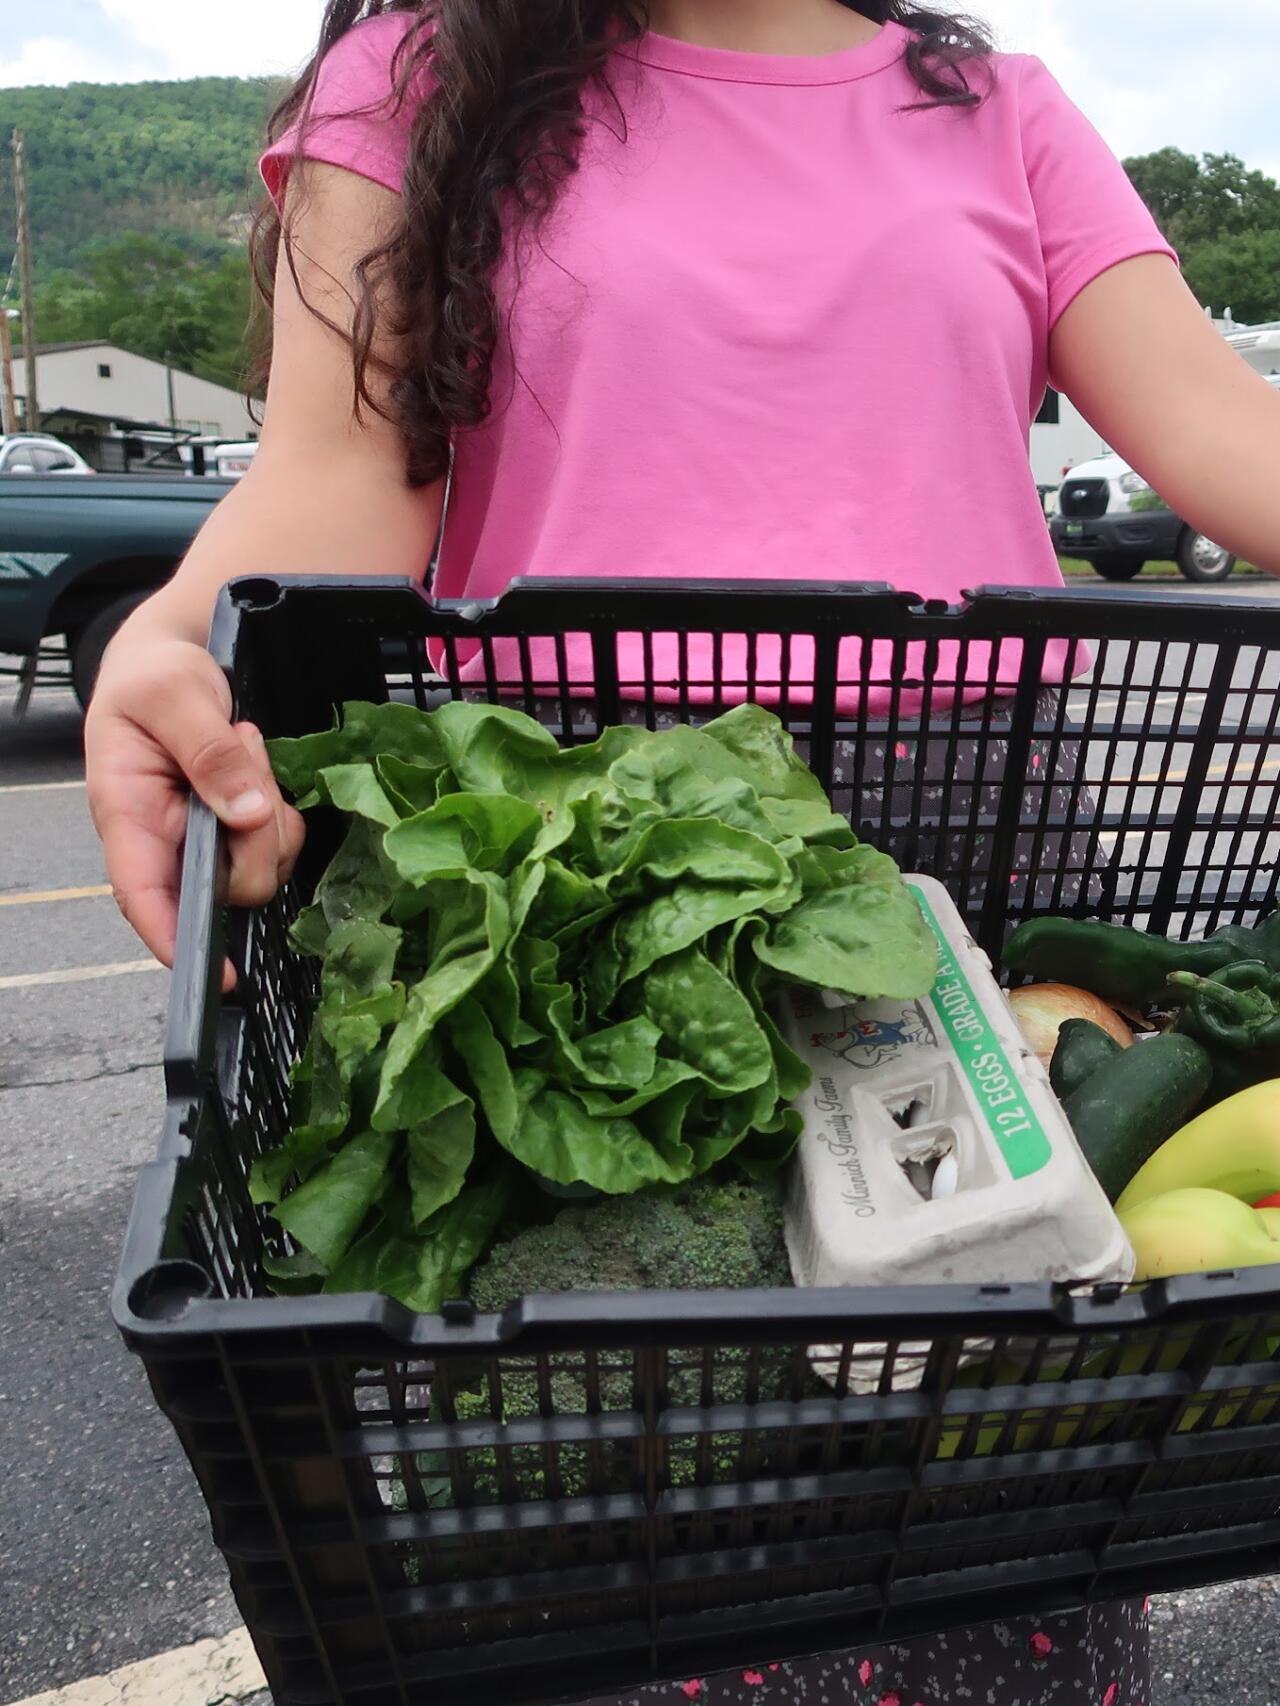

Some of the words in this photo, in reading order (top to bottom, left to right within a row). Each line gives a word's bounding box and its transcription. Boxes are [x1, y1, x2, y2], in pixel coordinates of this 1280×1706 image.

[936, 982, 985, 1042] GRADE
[814, 1076, 843, 1112] Farms
[970, 1052, 1017, 1106] EGGS
[825, 1114, 858, 1156] Family
[996, 1105, 1033, 1138] 12
[837, 1159, 876, 1218] Minnich
